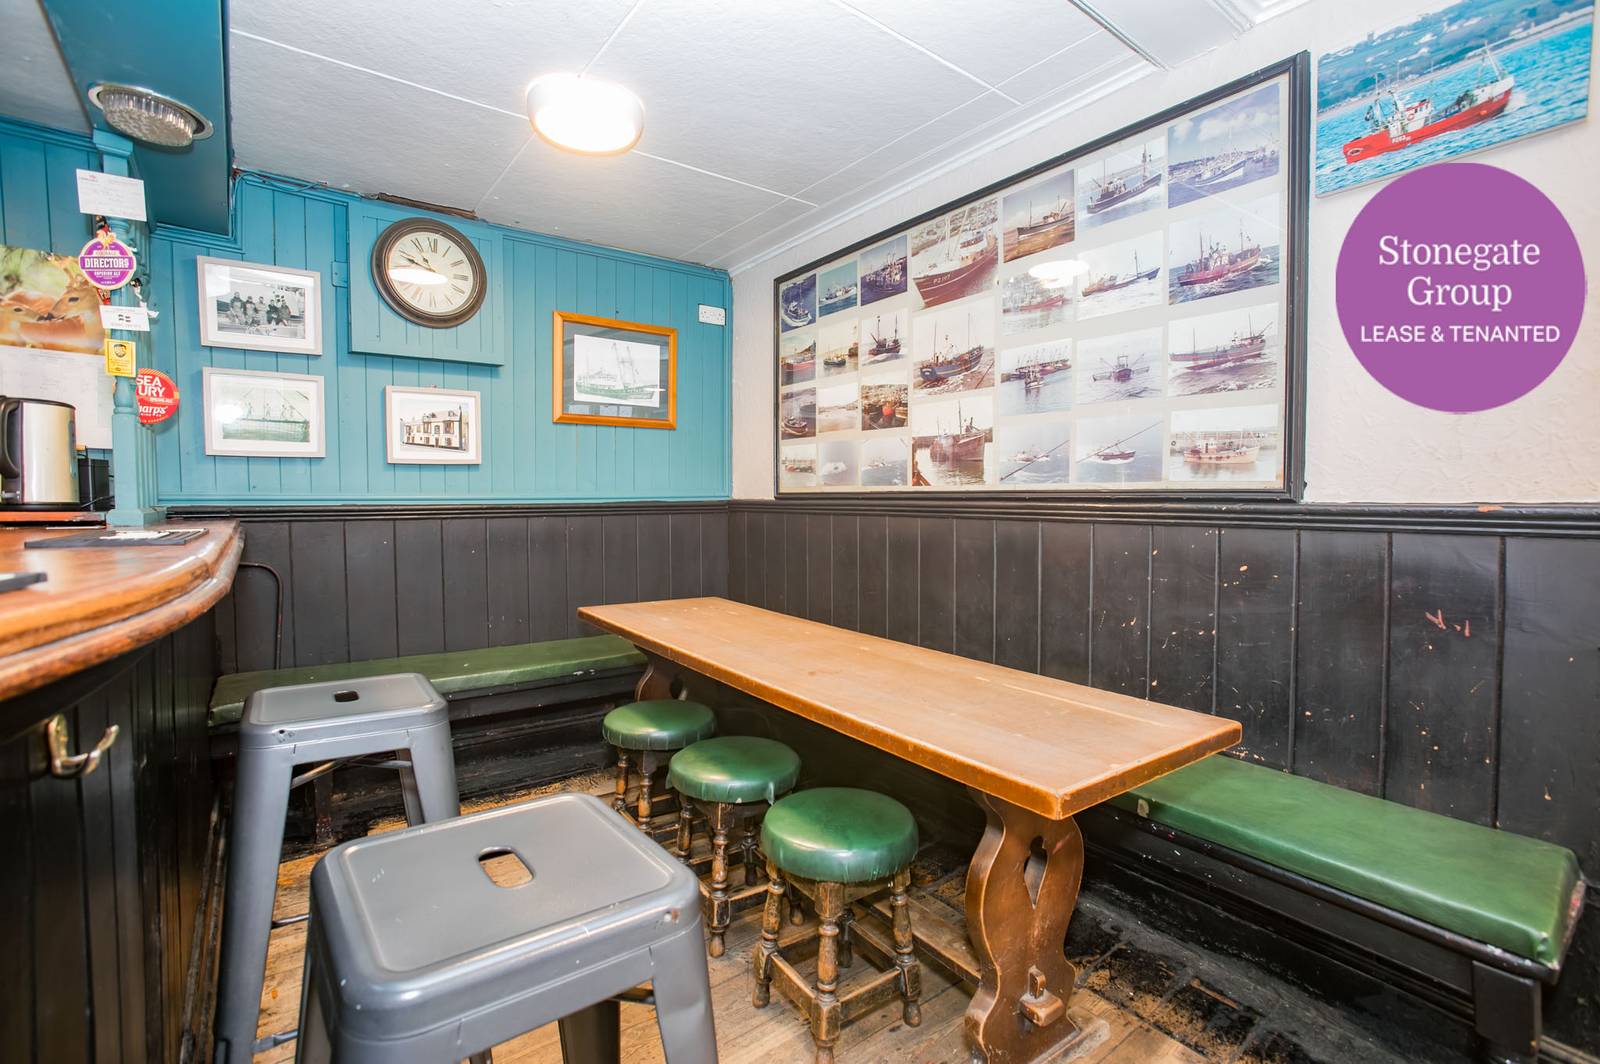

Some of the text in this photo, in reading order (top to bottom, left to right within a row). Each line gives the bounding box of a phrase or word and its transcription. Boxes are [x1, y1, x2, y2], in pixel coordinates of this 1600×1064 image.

[84, 257, 129, 269] DIRECTORS
[136, 374, 162, 387] SEA
[138, 384, 165, 397] URY
